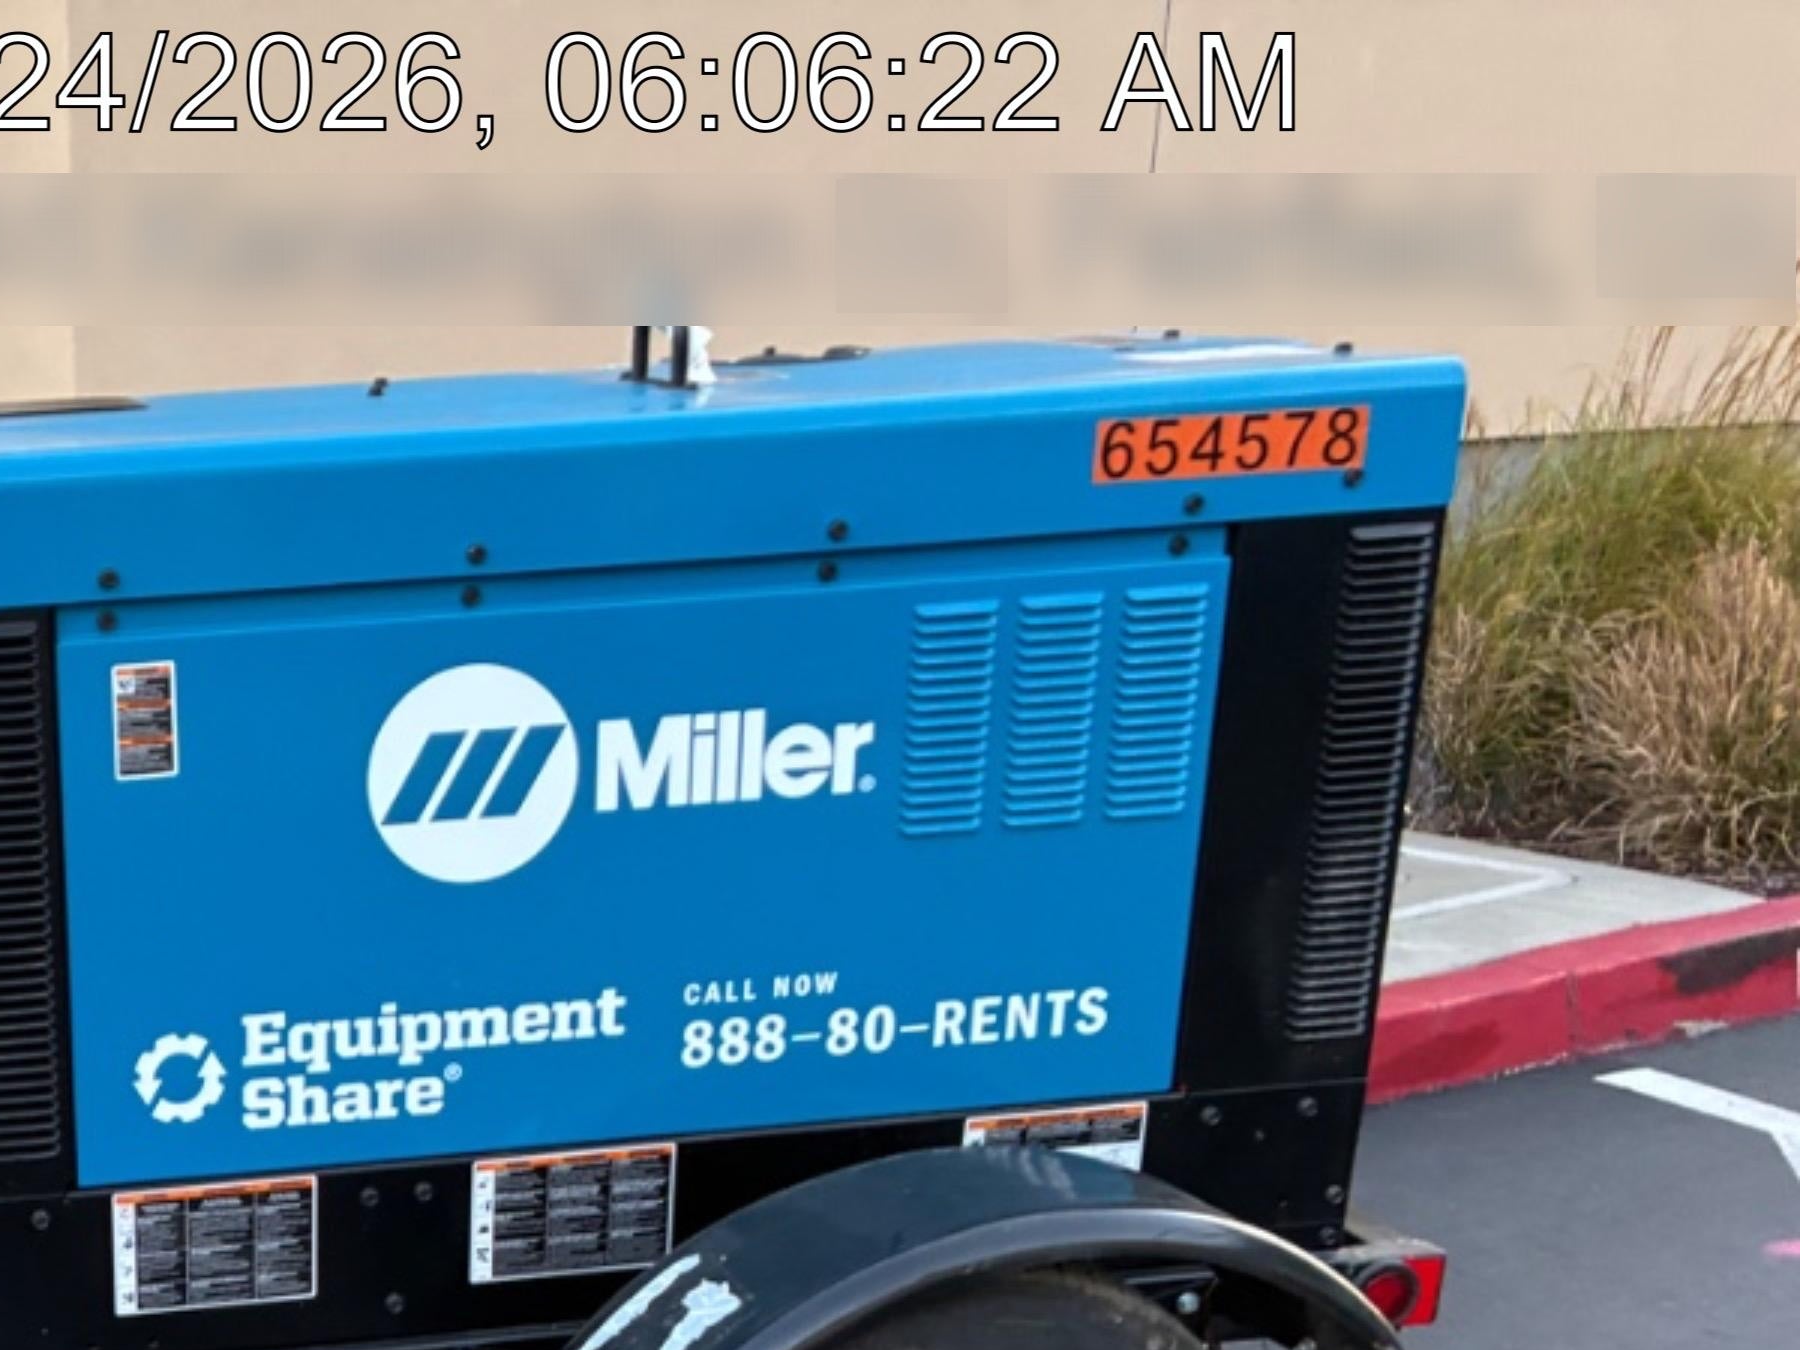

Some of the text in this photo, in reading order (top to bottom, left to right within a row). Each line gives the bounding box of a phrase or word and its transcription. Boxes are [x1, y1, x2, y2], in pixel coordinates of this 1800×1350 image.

[1101, 407, 1360, 480] 654578
[595, 708, 875, 812] Miller
[241, 987, 628, 1073] Equipment
[680, 986, 1110, 1069] 888-80-RENTS
[683, 972, 839, 1006] CALL NOW
